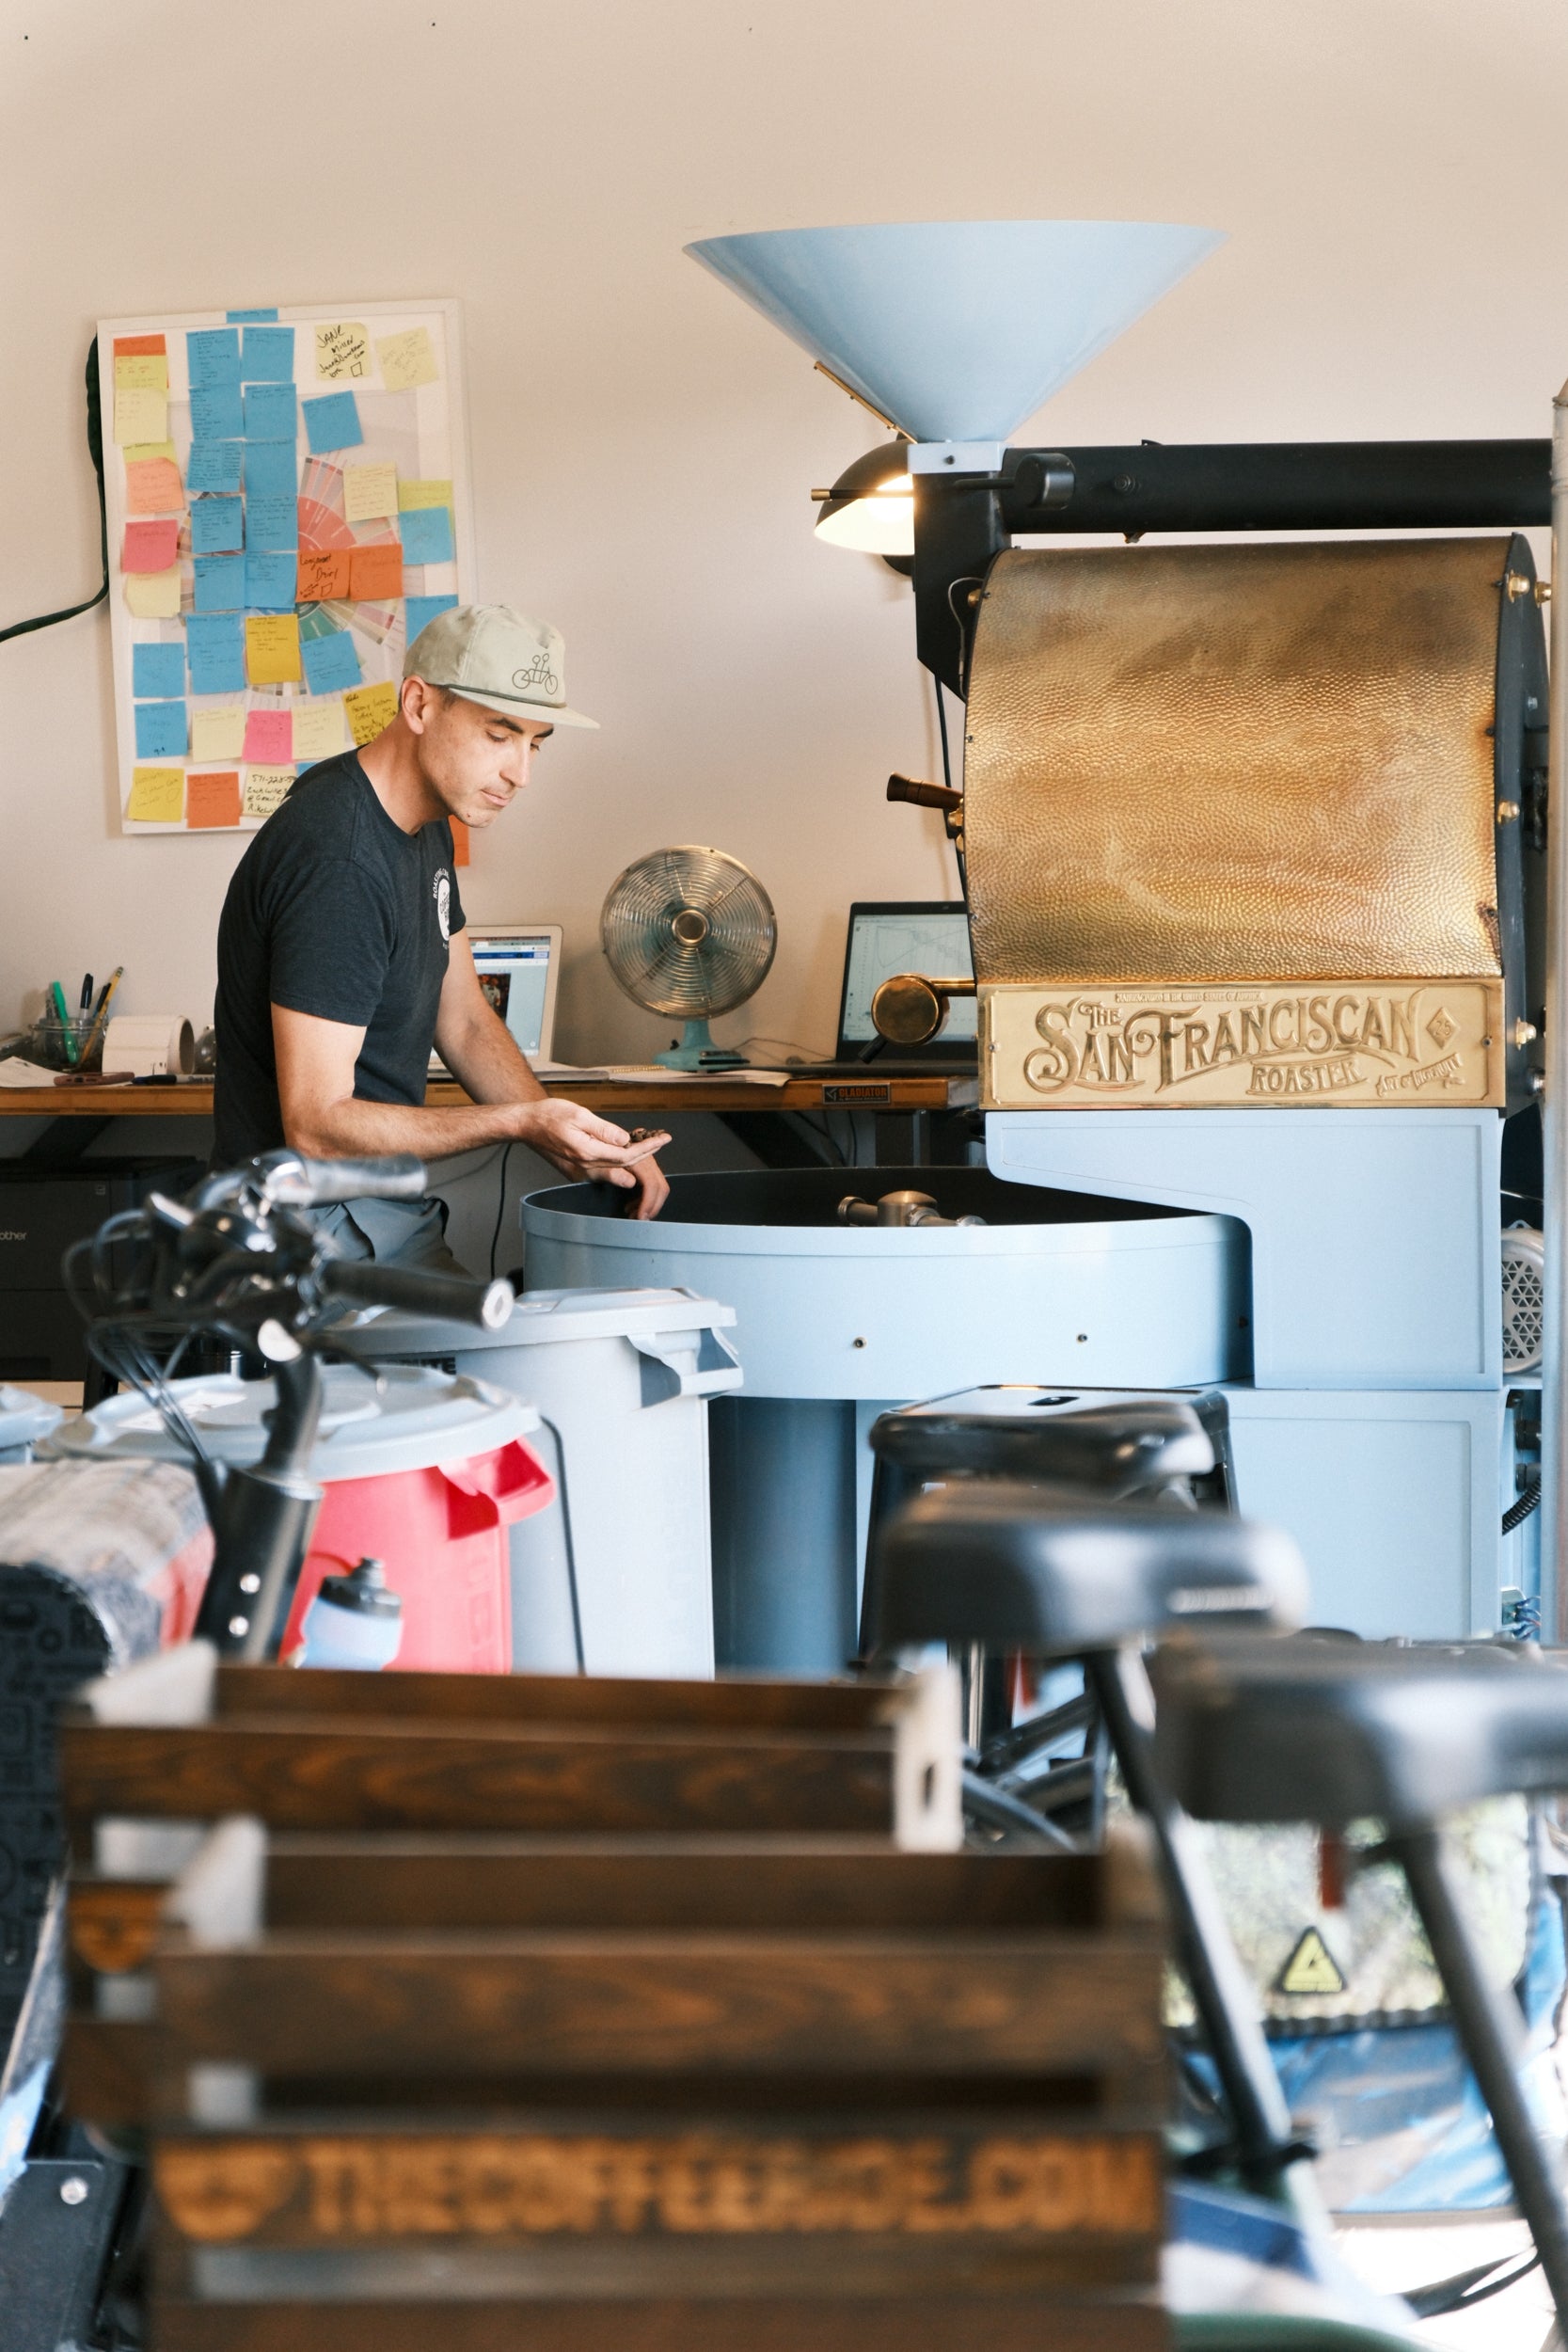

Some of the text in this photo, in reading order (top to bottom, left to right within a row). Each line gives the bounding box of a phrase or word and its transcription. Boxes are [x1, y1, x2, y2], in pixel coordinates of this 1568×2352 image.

[1078, 1000, 1124, 1031] THE
[1023, 988, 1427, 1095] SAN FRANCISCAN
[1250, 1055, 1363, 1092] ROASTER
